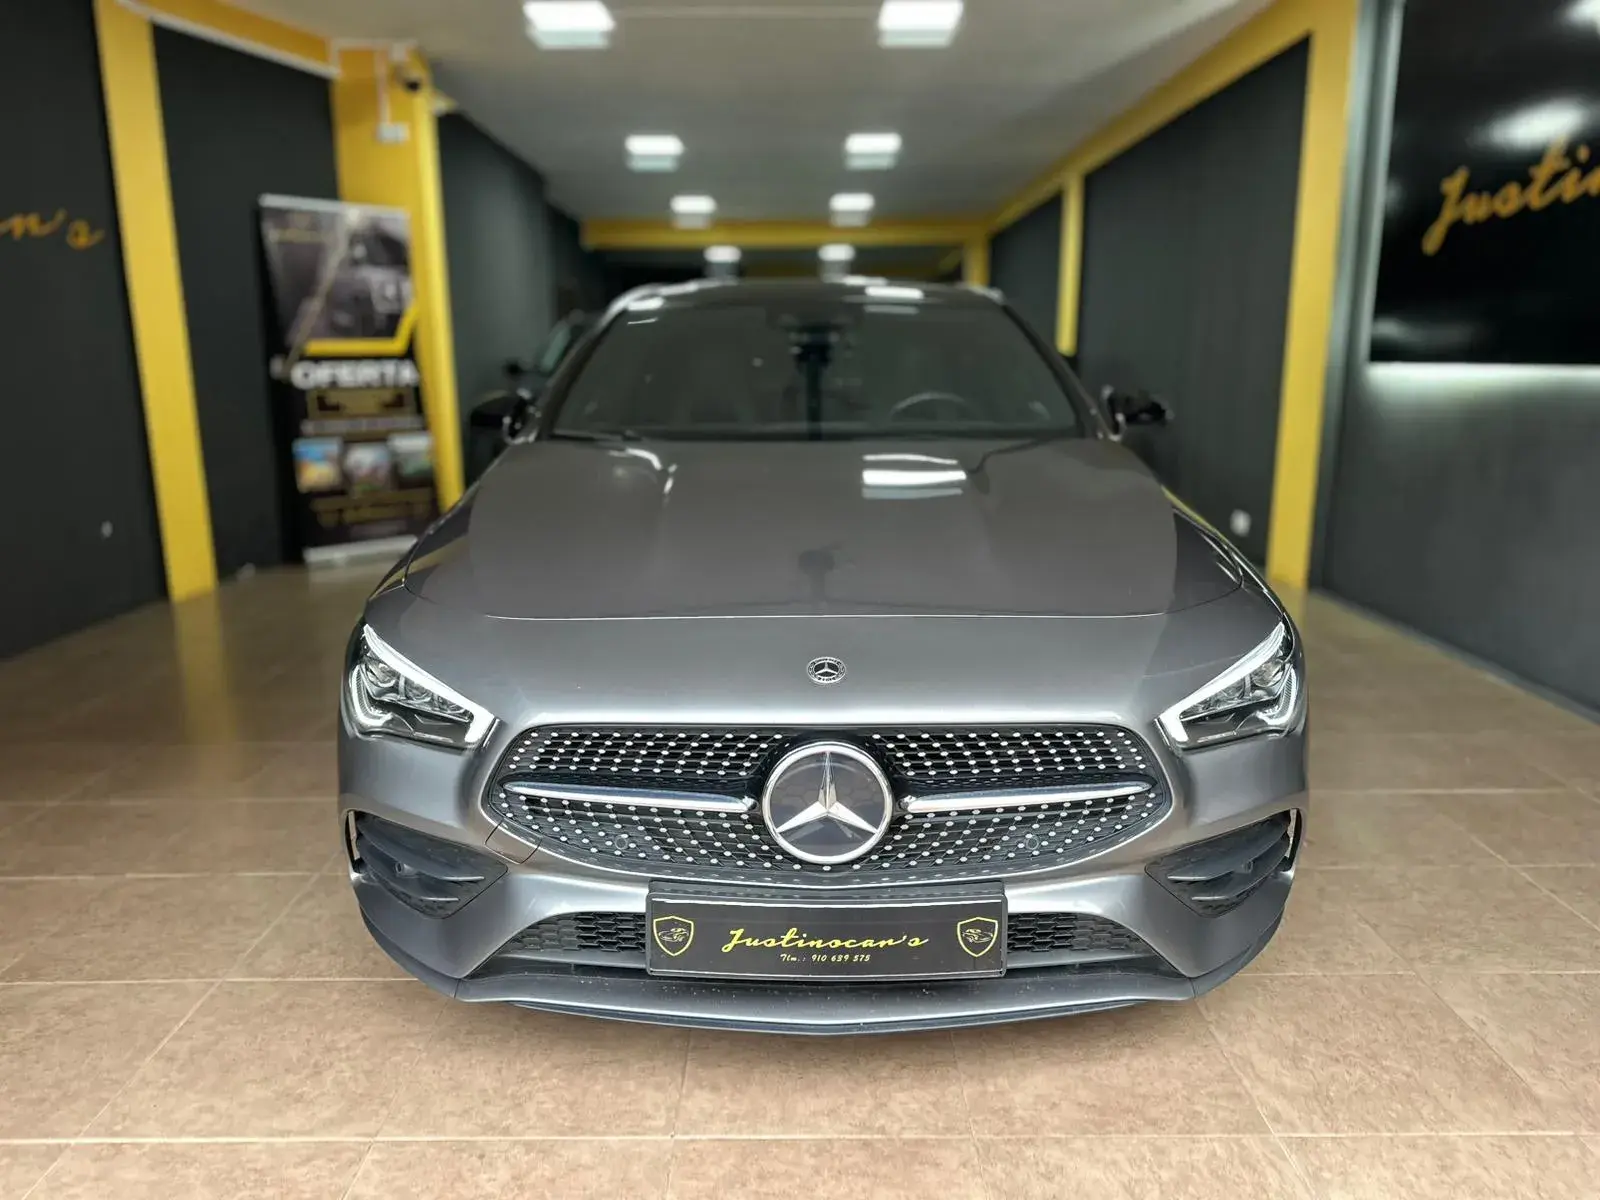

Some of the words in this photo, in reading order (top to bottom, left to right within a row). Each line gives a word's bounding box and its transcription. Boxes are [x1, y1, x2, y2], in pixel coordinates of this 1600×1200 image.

[290, 360, 419, 390] OFERTA
[721, 927, 929, 953] Justinocar's
[811, 954, 828, 962] 910
[852, 954, 871, 962] 575
